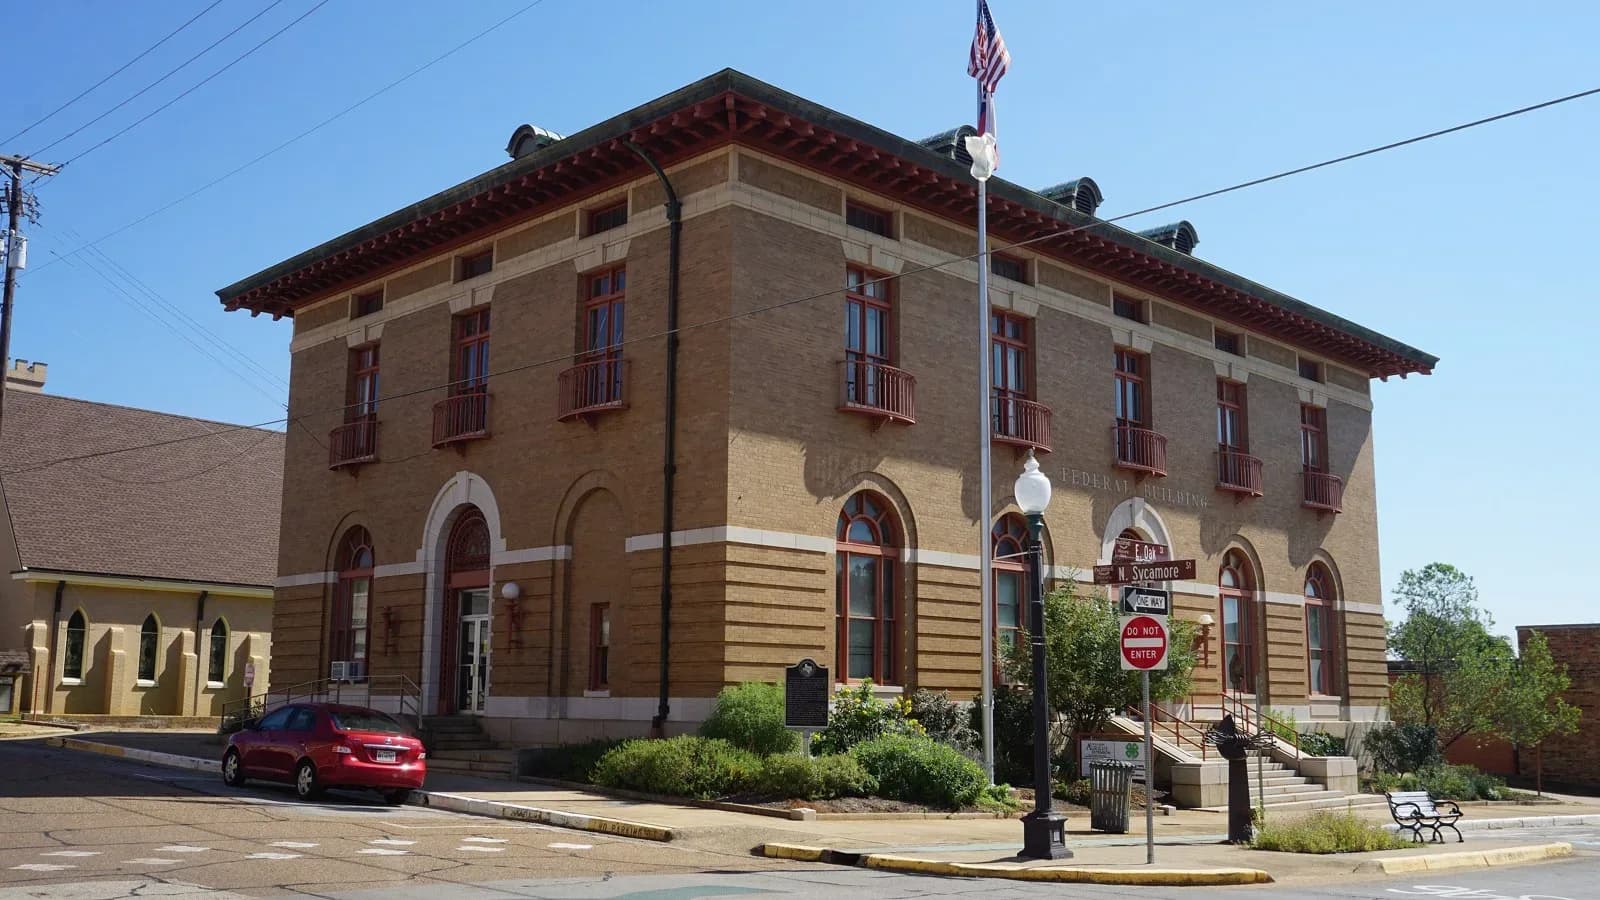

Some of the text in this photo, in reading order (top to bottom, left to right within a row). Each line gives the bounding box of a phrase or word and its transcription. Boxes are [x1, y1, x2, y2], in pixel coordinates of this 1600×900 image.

[1061, 468, 1209, 508] FEDERAL BUILDING
[1143, 544, 1156, 561] Oak
[1118, 567, 1128, 581] N.
[1132, 565, 1179, 582] Sycamore
[1136, 595, 1165, 609] ONE WAY
[1127, 626, 1160, 636] DO NOT
[1130, 650, 1157, 659] ENTER
